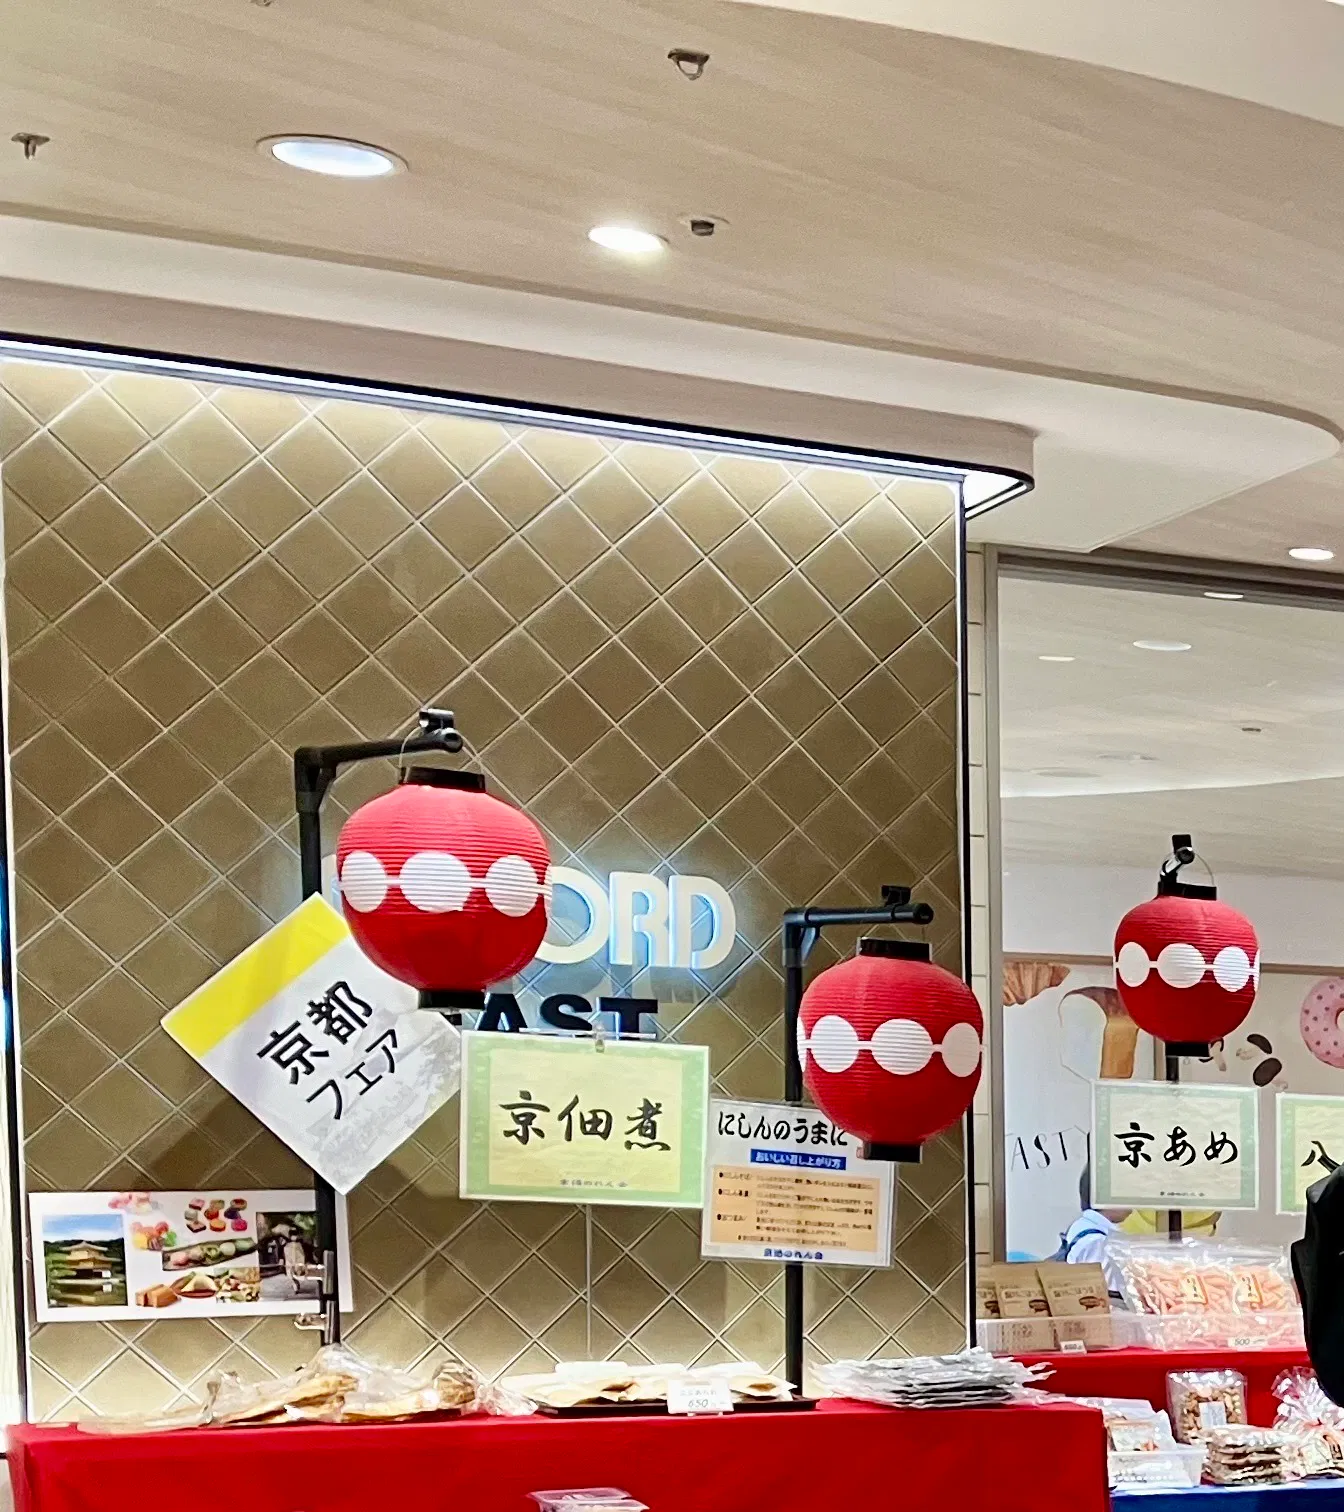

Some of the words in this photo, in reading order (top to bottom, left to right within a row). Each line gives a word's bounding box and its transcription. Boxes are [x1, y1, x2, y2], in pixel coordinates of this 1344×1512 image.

[537, 865, 736, 969] ORD
[257, 980, 373, 1085] 京都
[476, 992, 659, 1040] AST
[305, 1028, 399, 1120] フェア
[499, 1089, 672, 1152] 京佃煮
[718, 1111, 848, 1147] にしんのうまに
[1005, 1124, 1091, 1172] ASTY
[1114, 1121, 1239, 1169] 京あめ
